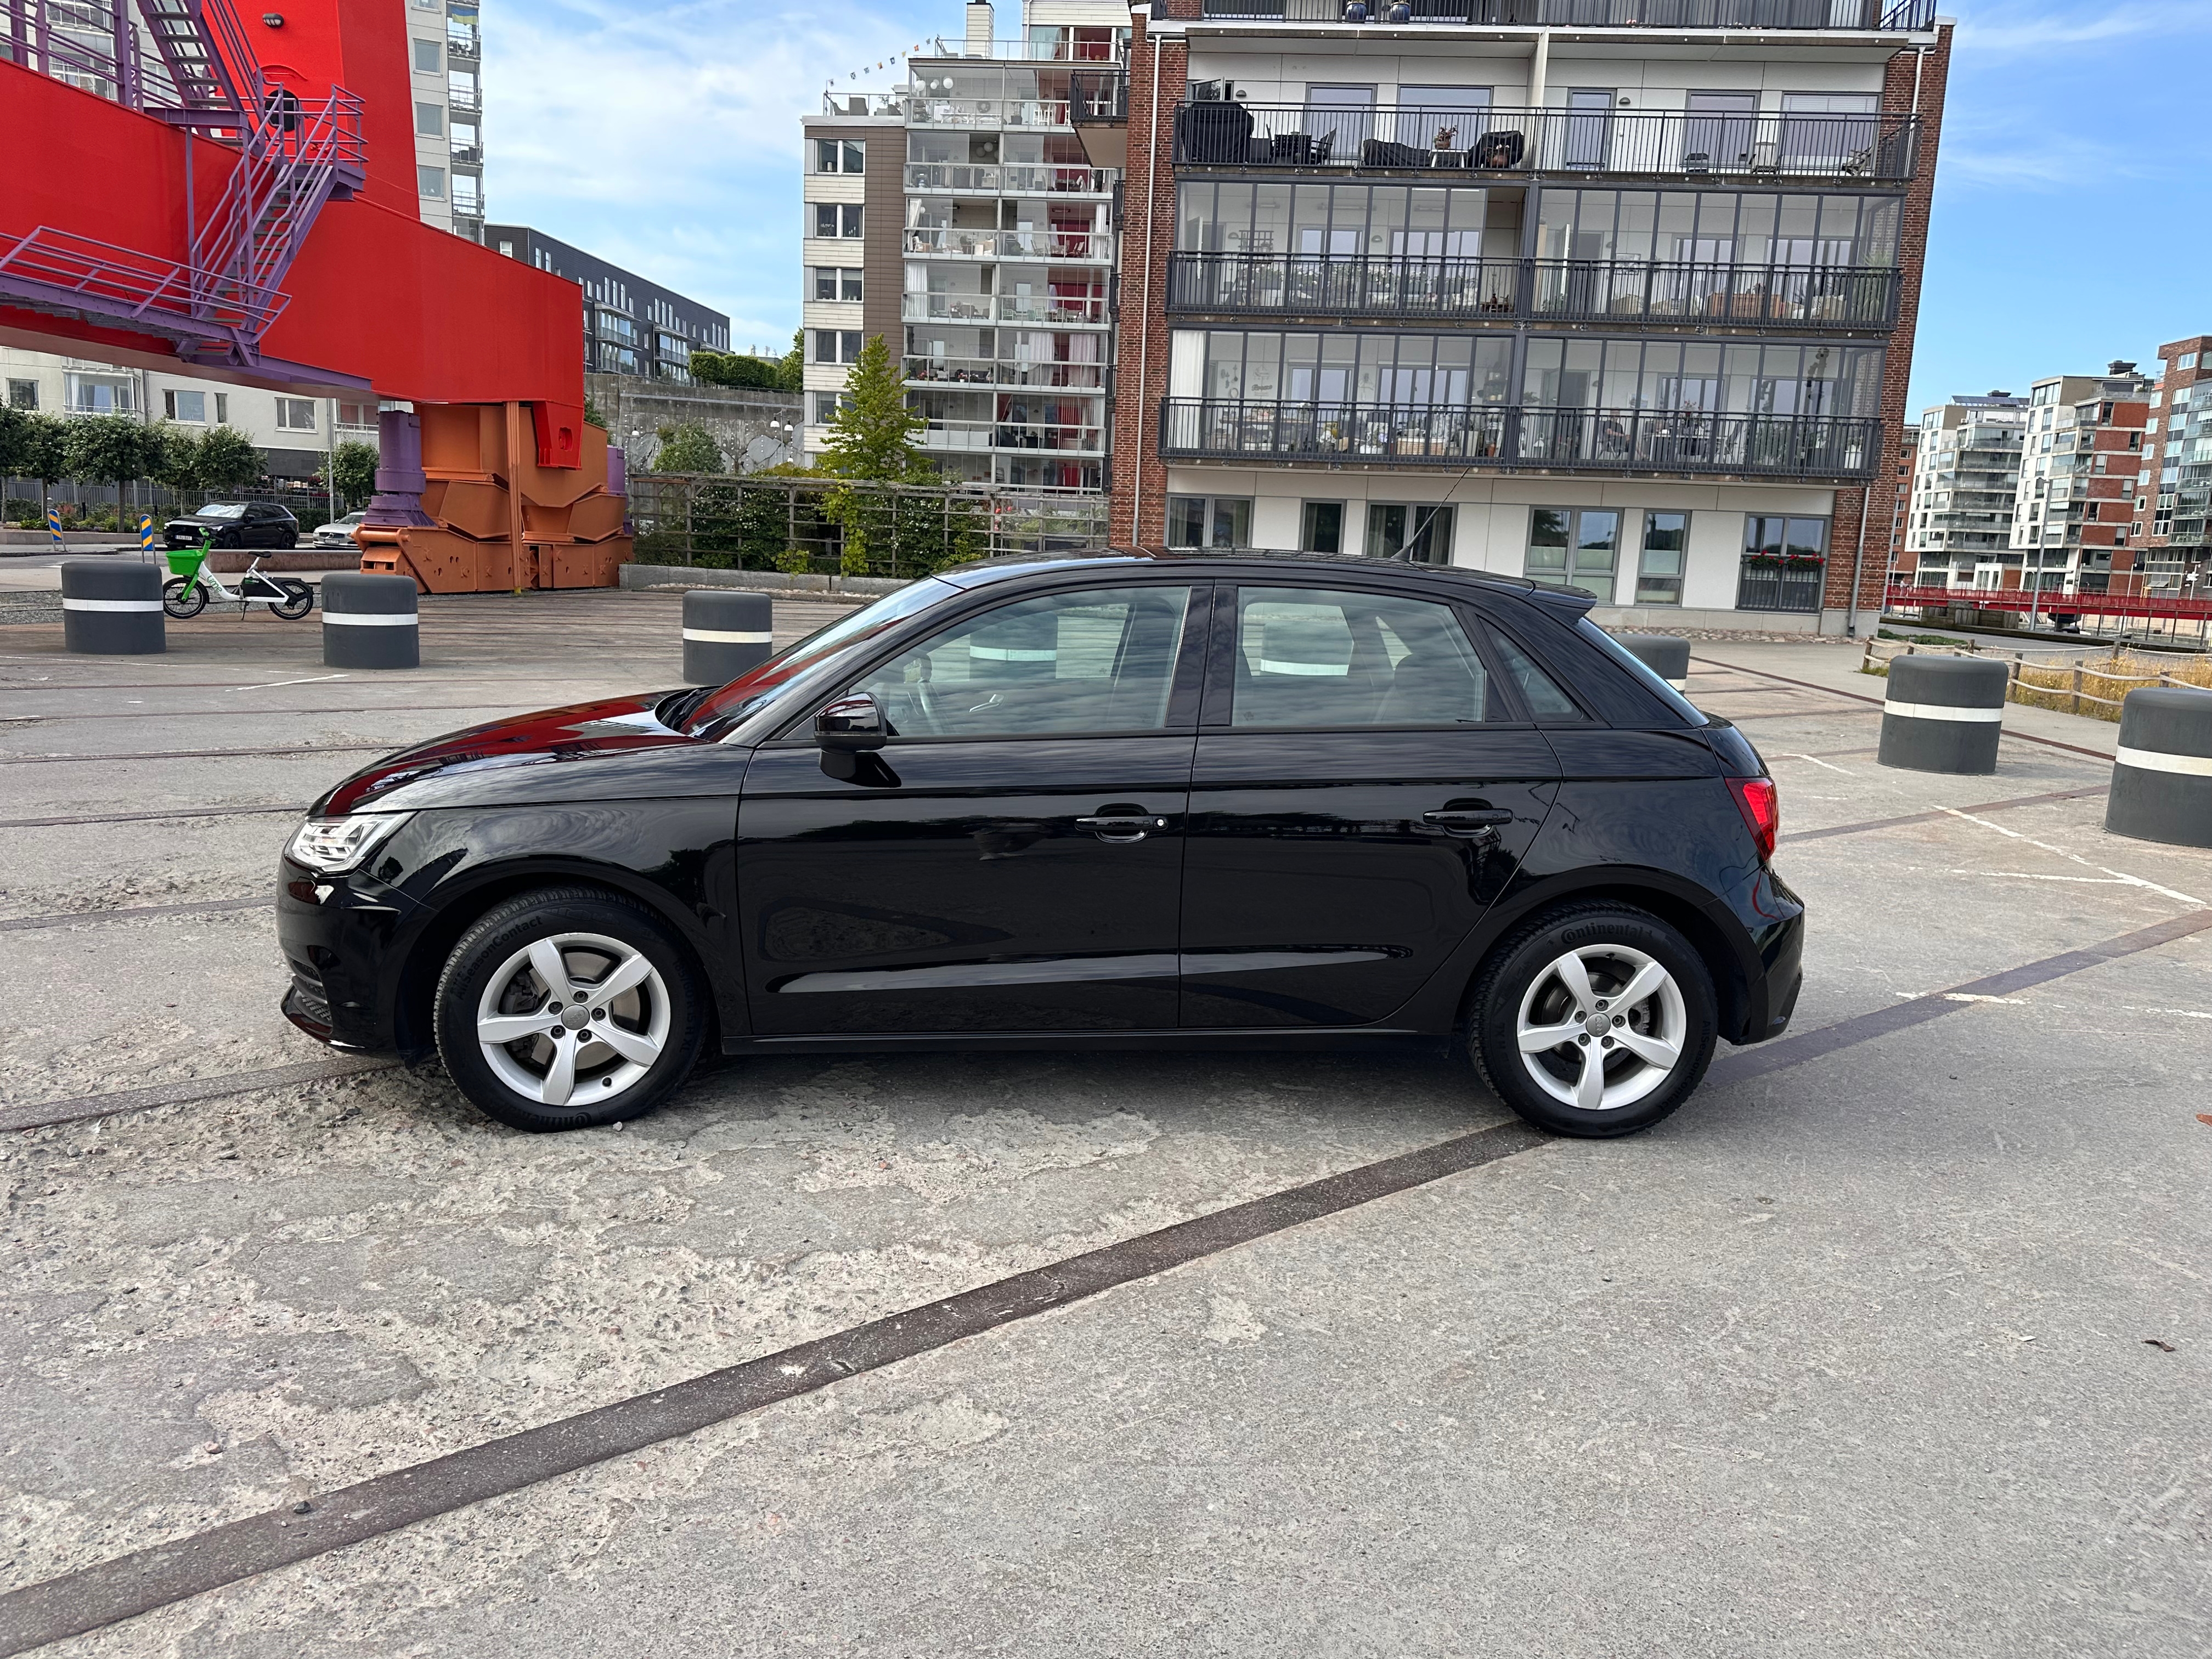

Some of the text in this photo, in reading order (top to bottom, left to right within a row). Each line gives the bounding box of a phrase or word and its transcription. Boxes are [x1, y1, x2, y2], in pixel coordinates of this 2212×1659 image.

[207, 575, 222, 592] Lime
[456, 916, 543, 1000] AllSeasonContact
[1560, 922, 1643, 944] Continental
[1658, 1020, 1711, 1111] AllSeasonContact
